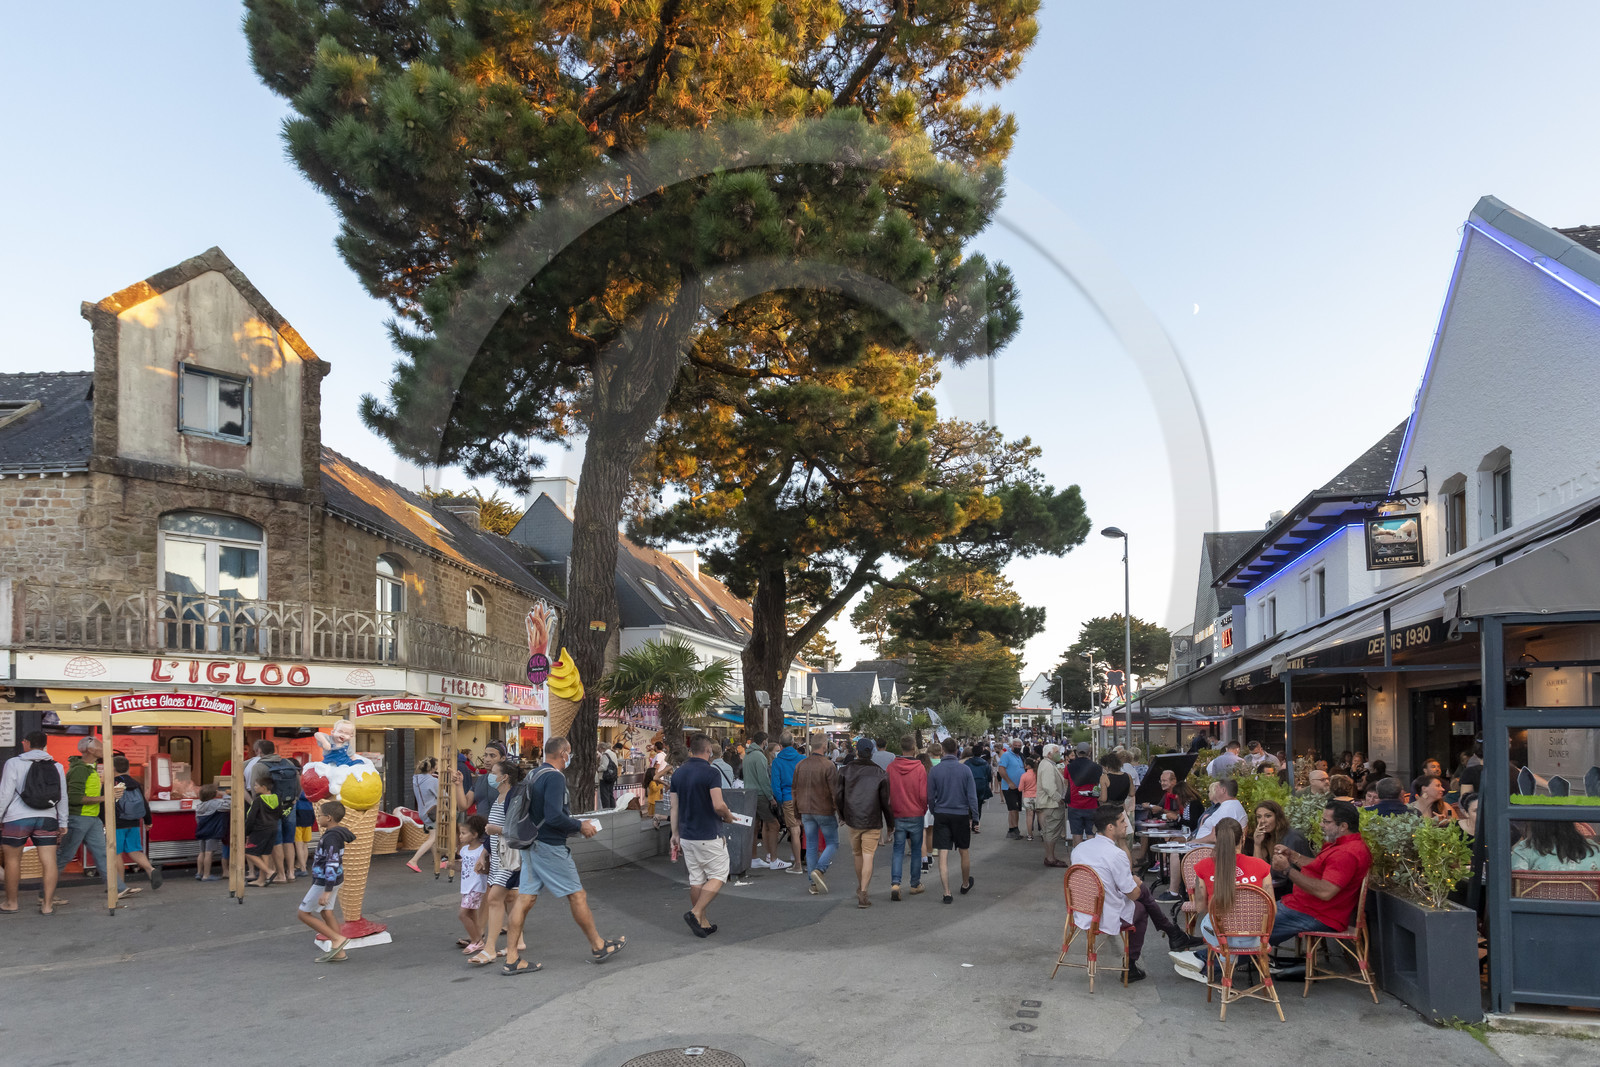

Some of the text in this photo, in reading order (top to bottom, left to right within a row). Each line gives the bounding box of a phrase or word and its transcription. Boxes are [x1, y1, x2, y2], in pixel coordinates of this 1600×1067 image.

[1406, 625, 1431, 646] 1930
[151, 658, 310, 686] L'IGLOO
[441, 677, 485, 697] L'IGLOO
[113, 695, 233, 713] Entrée Glaces à l'Italienne
[358, 700, 450, 715] Entrée Glaces à l'Italienne
[1548, 749, 1570, 758] DINNER
